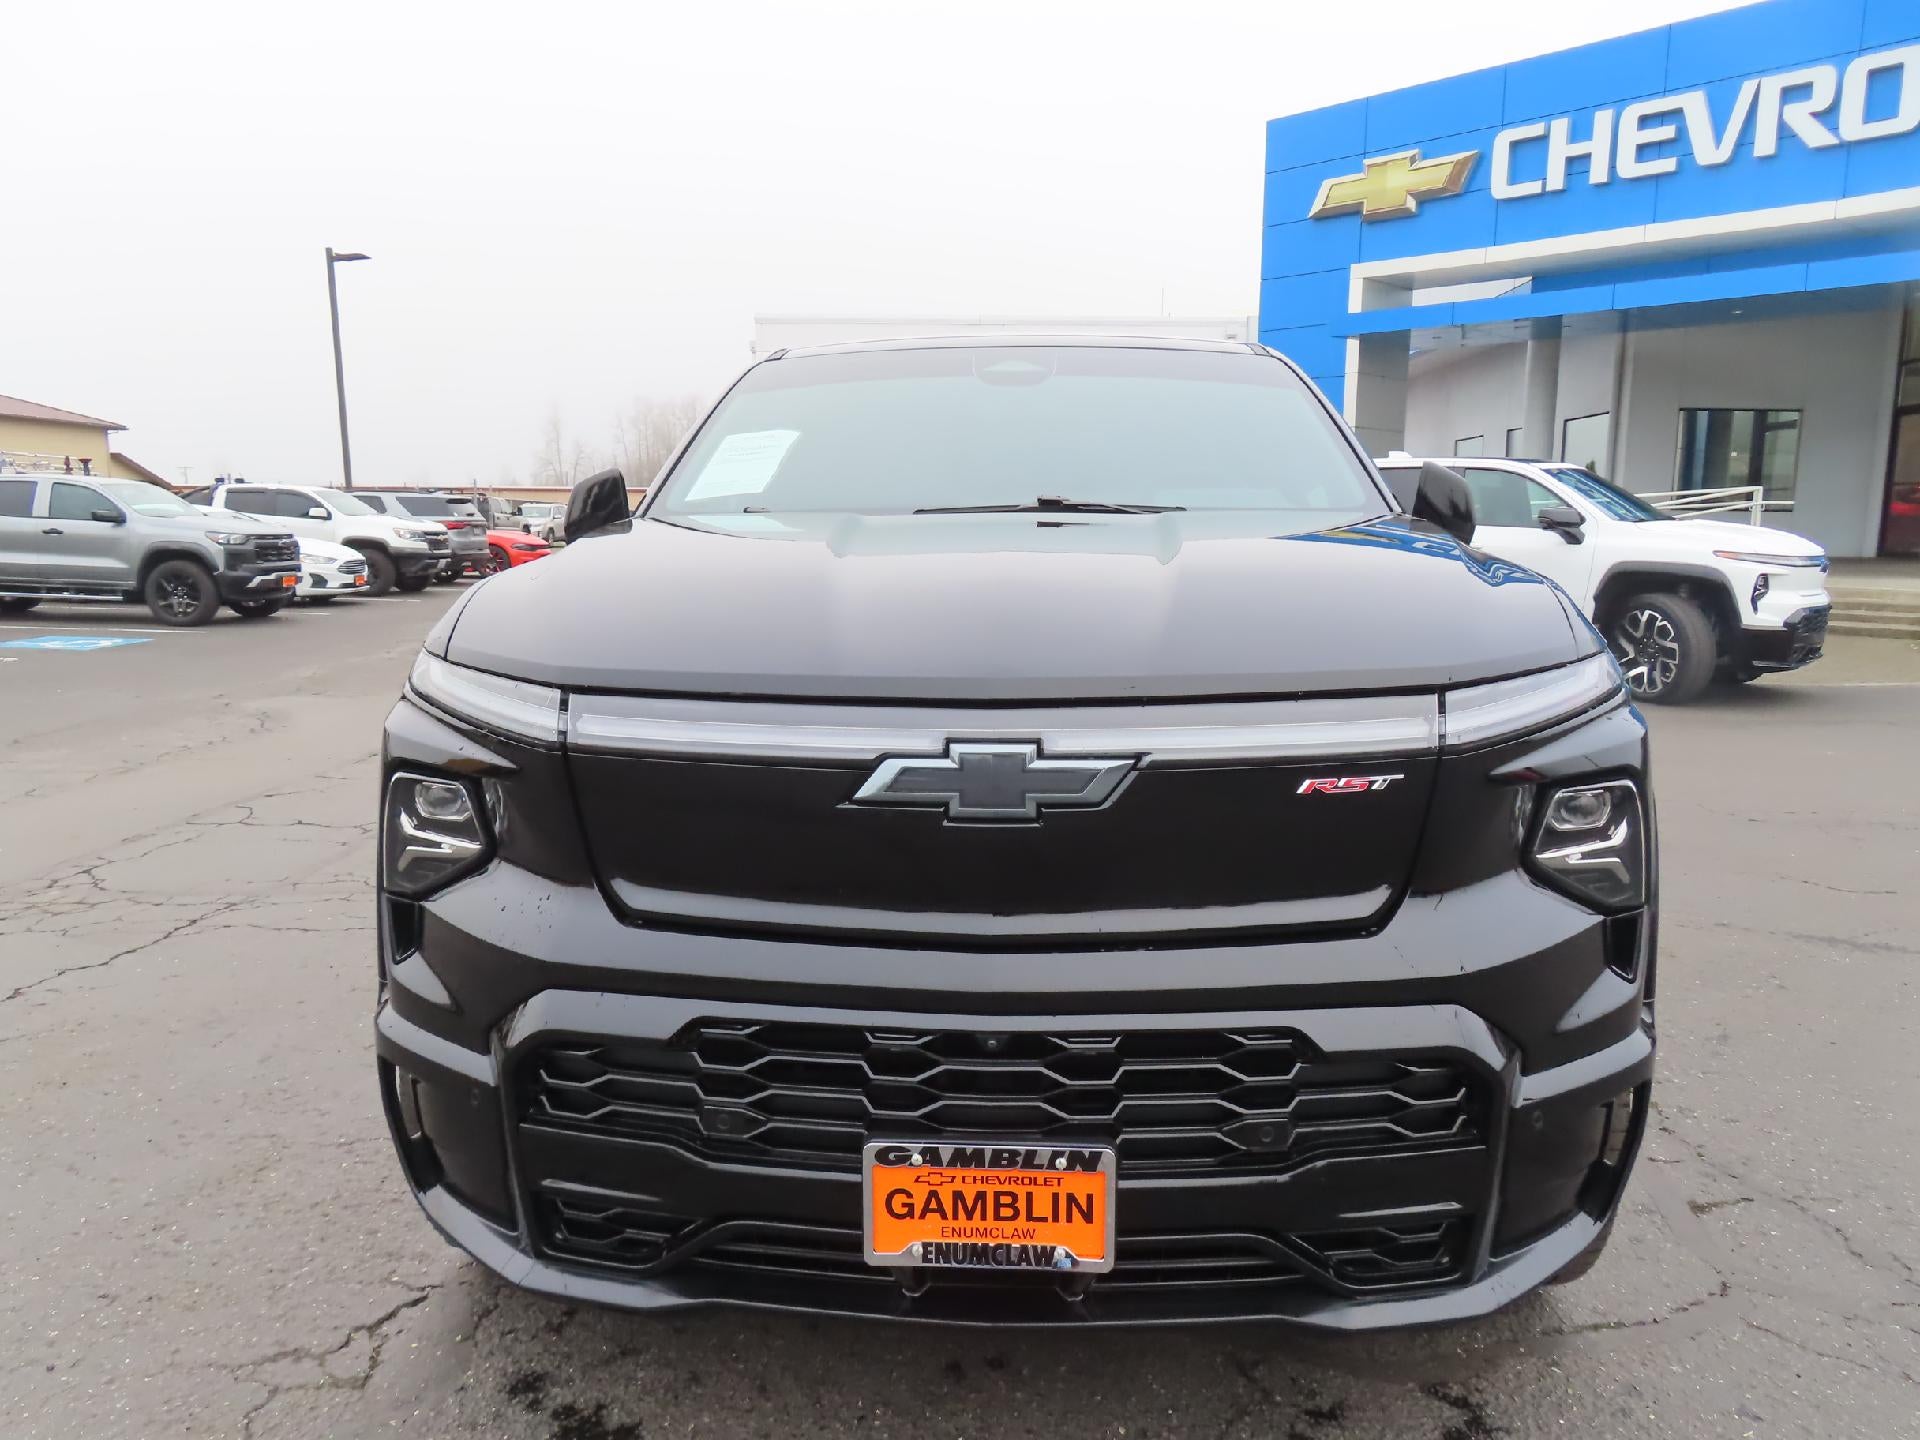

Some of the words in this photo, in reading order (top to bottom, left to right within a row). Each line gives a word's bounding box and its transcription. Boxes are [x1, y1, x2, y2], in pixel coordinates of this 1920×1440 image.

[1296, 774, 1405, 794] RST
[874, 1145, 1101, 1172] GAMBLIN
[961, 1175, 1064, 1187] CHEVROLET
[884, 1188, 1094, 1225] GAMBLIN
[941, 1226, 1036, 1240] ENUMCLAW
[921, 1241, 1056, 1266] ENUMCLAW
